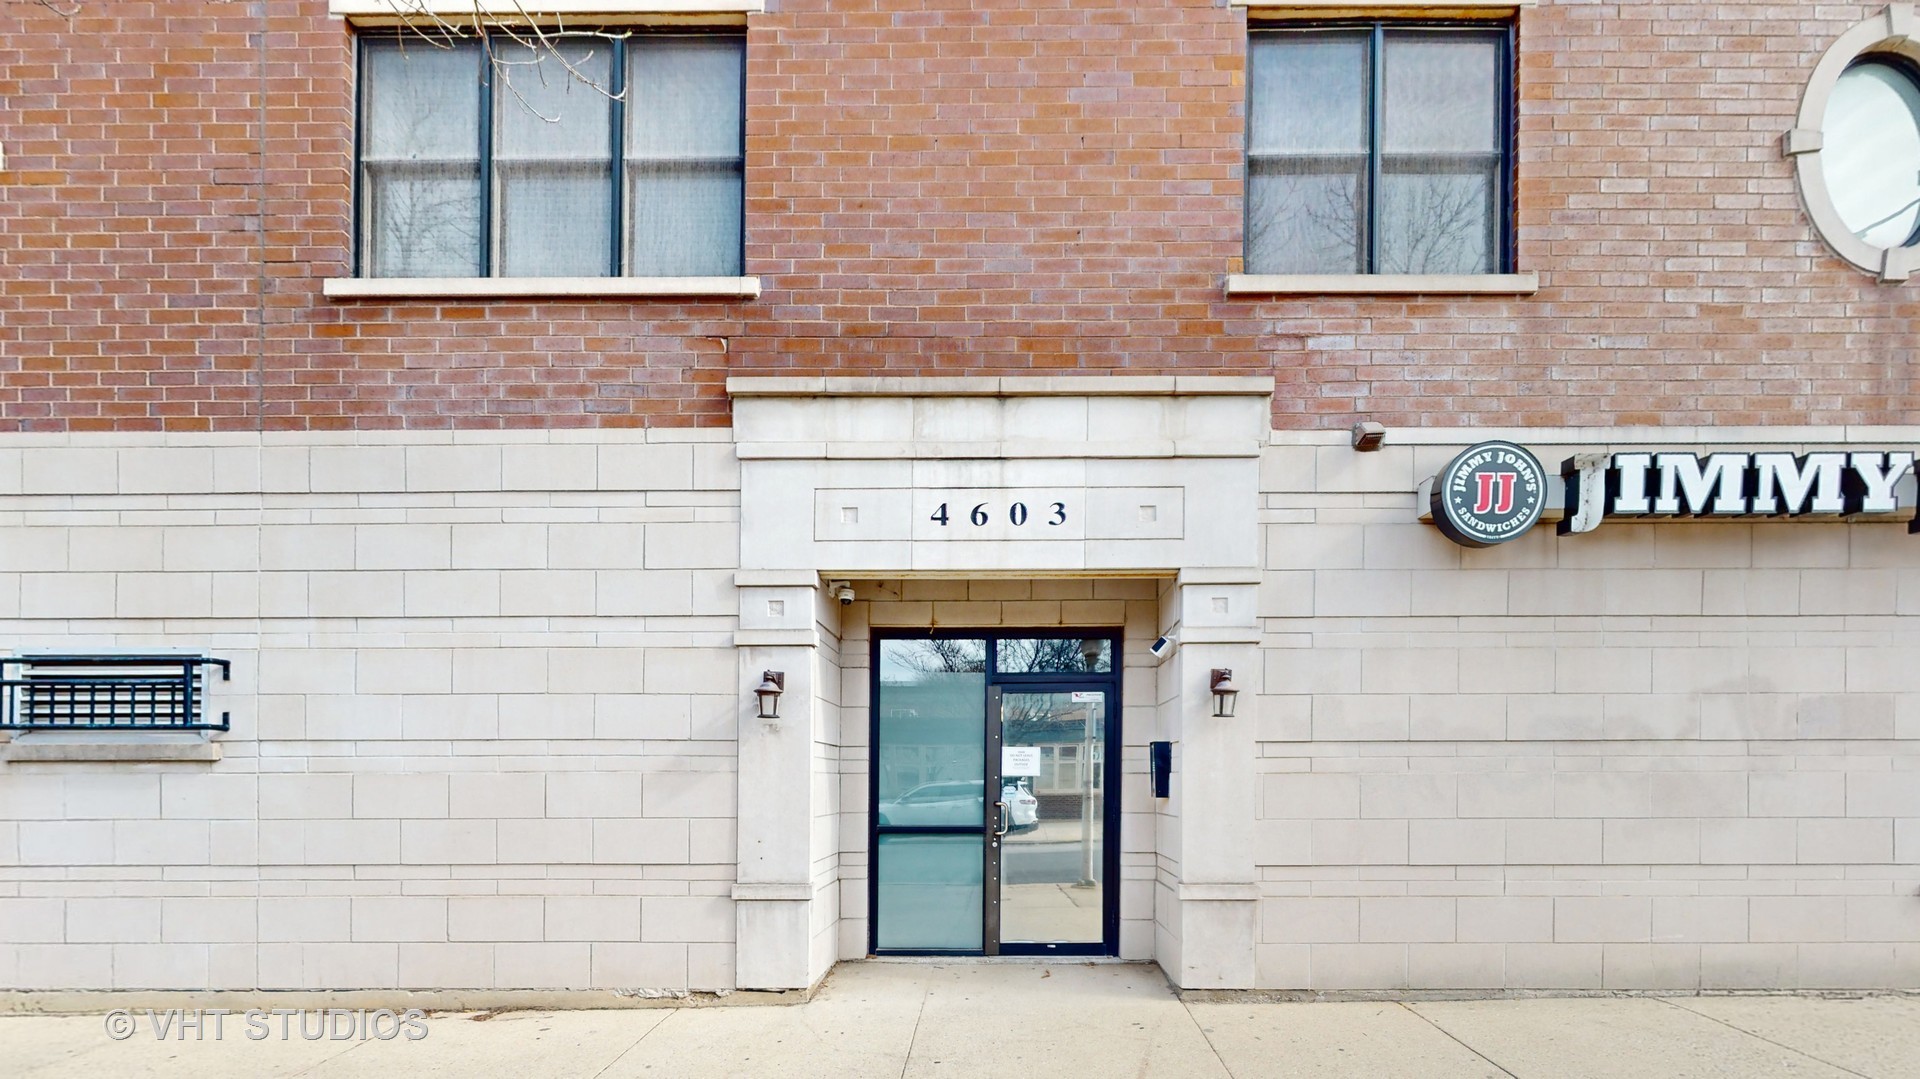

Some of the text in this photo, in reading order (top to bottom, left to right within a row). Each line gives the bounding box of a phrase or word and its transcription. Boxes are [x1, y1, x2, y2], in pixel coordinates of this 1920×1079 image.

[1453, 451, 1537, 492] JIMMY JOHN'S
[1571, 451, 1914, 533] JIMMY
[1473, 472, 1517, 514] JJ
[930, 502, 1067, 526] 4603
[1458, 507, 1531, 532] SANDWICHES
